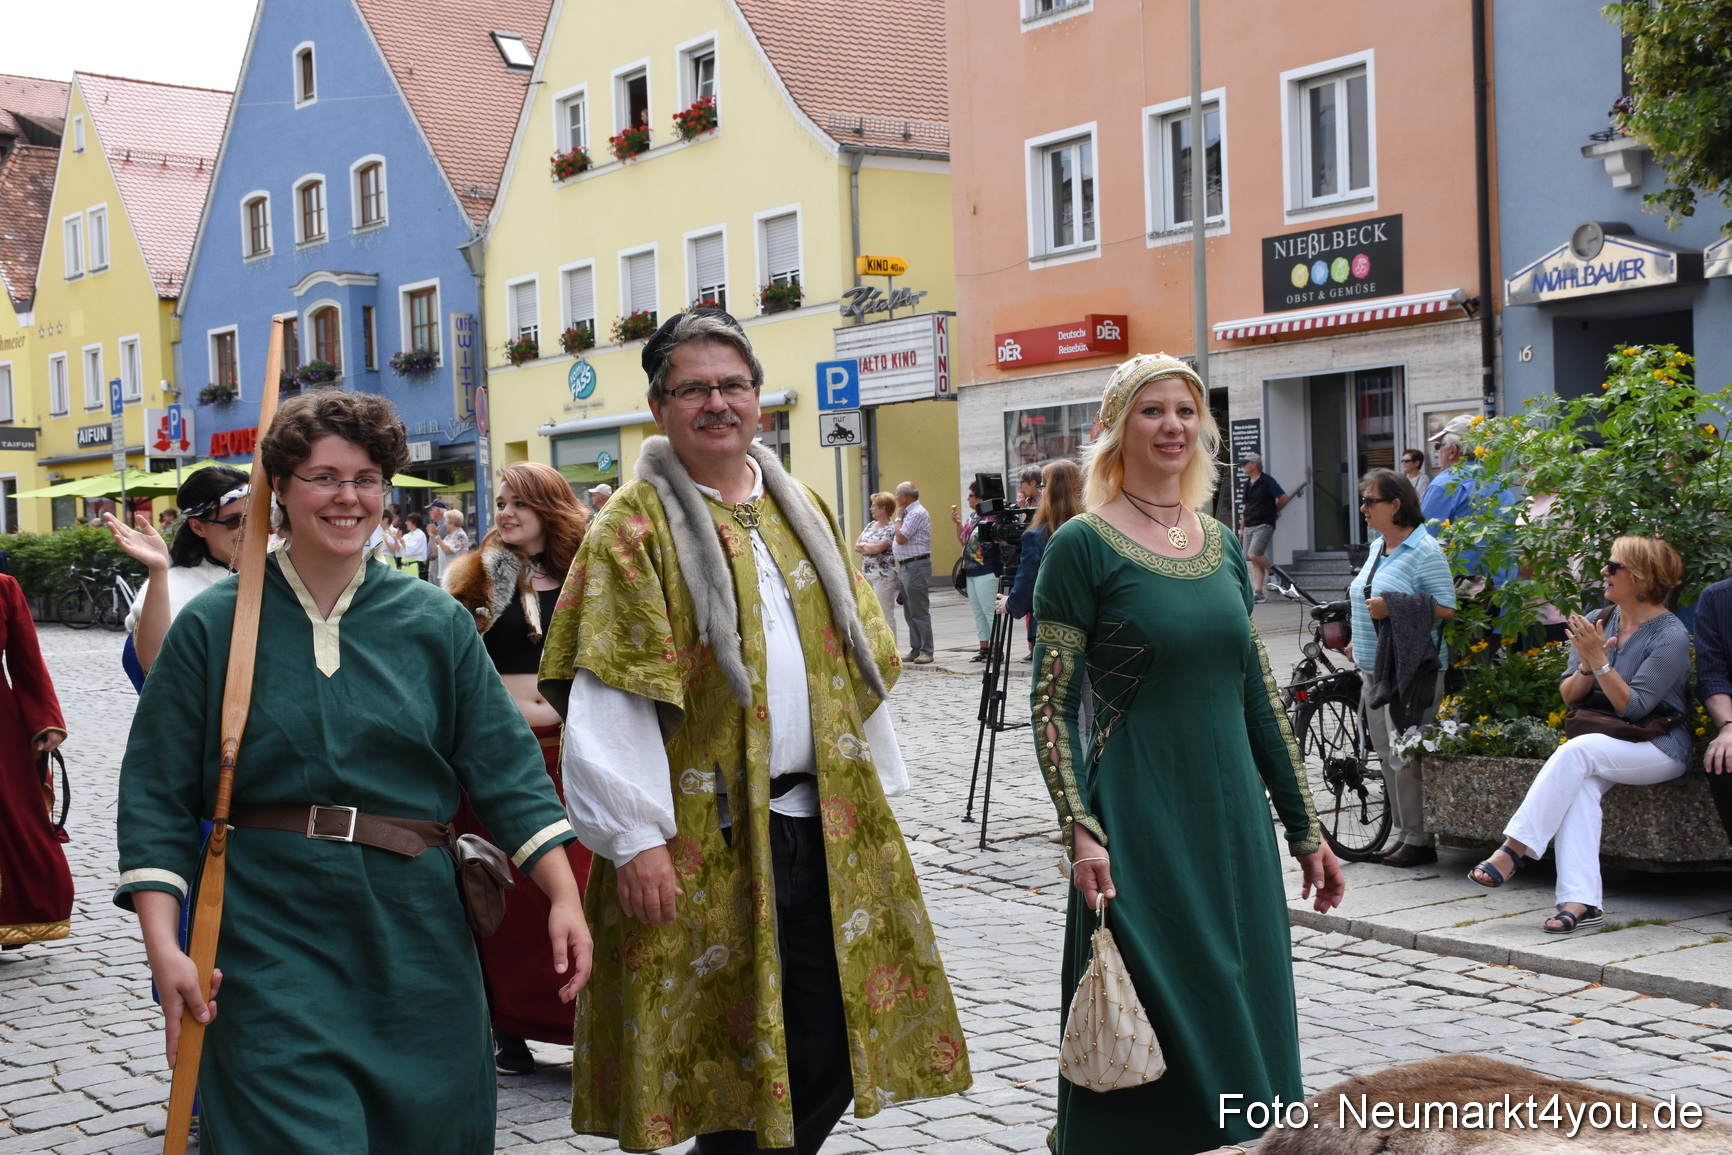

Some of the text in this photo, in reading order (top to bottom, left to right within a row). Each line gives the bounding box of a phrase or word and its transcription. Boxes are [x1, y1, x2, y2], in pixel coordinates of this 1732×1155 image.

[867, 259, 888, 272] KINO
[1531, 257, 1646, 294] MÜHLBAUER
[1286, 282, 1377, 305] OBST & GEMÜSE
[1096, 322, 1121, 340] DER
[858, 350, 917, 373] IALTO KINO
[936, 317, 948, 393] KINO
[998, 340, 1023, 362] DER
[1519, 345, 1533, 362] 16
[571, 366, 592, 401] FASS
[826, 367, 849, 405] P
[112, 384, 120, 411] P
[170, 408, 178, 436] P
[832, 415, 846, 423] nur
[74, 427, 107, 444] TAIFUN
[209, 427, 258, 457] APOTH
